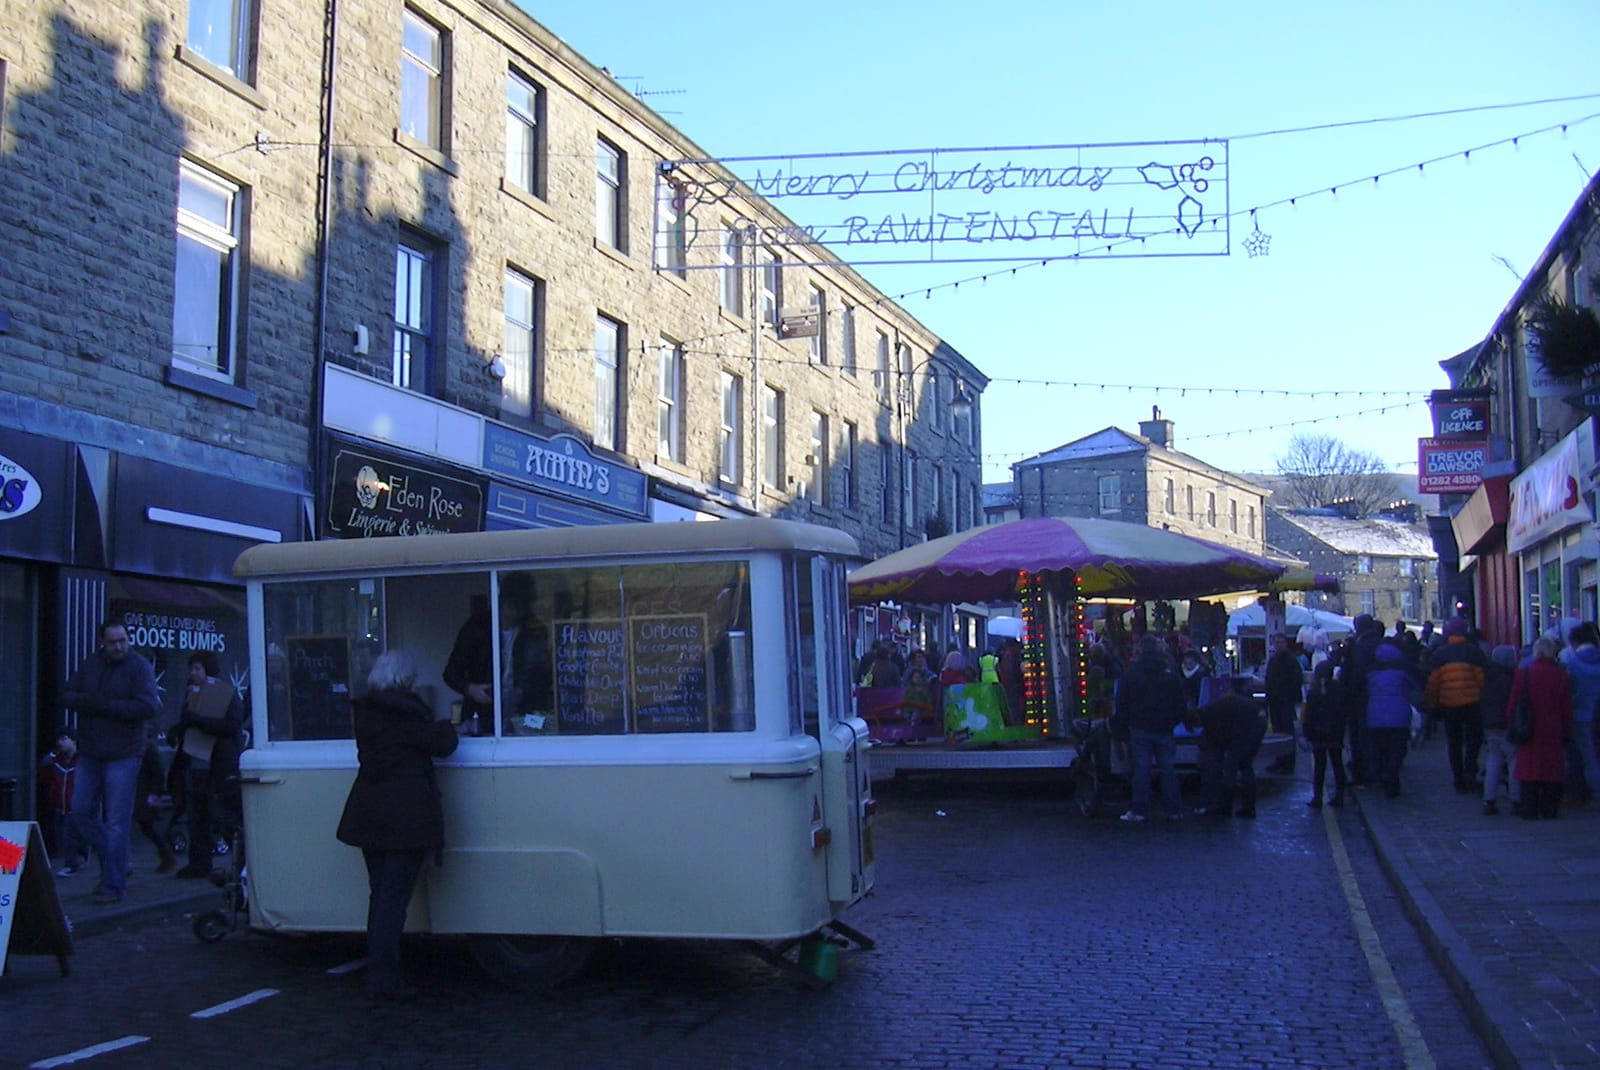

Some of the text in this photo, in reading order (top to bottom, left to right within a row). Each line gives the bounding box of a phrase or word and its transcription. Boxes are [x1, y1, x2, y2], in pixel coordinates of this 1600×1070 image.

[754, 161, 1111, 200] Merry Christmas
[842, 205, 1142, 246] RAWTENSTALL
[1450, 407, 1473, 420] OFF
[1440, 420, 1484, 434] LICENCE
[1428, 450, 1482, 463] TREVOR
[1428, 460, 1484, 472] DAWSON
[1421, 475, 1450, 486] 01282
[385, 474, 463, 520] Eden Rose
[347, 507, 397, 537] Lingerie
[145, 614, 168, 628] YOUR
[169, 616, 194, 630] LOVED
[127, 626, 225, 652] GOOSE BUMPS
